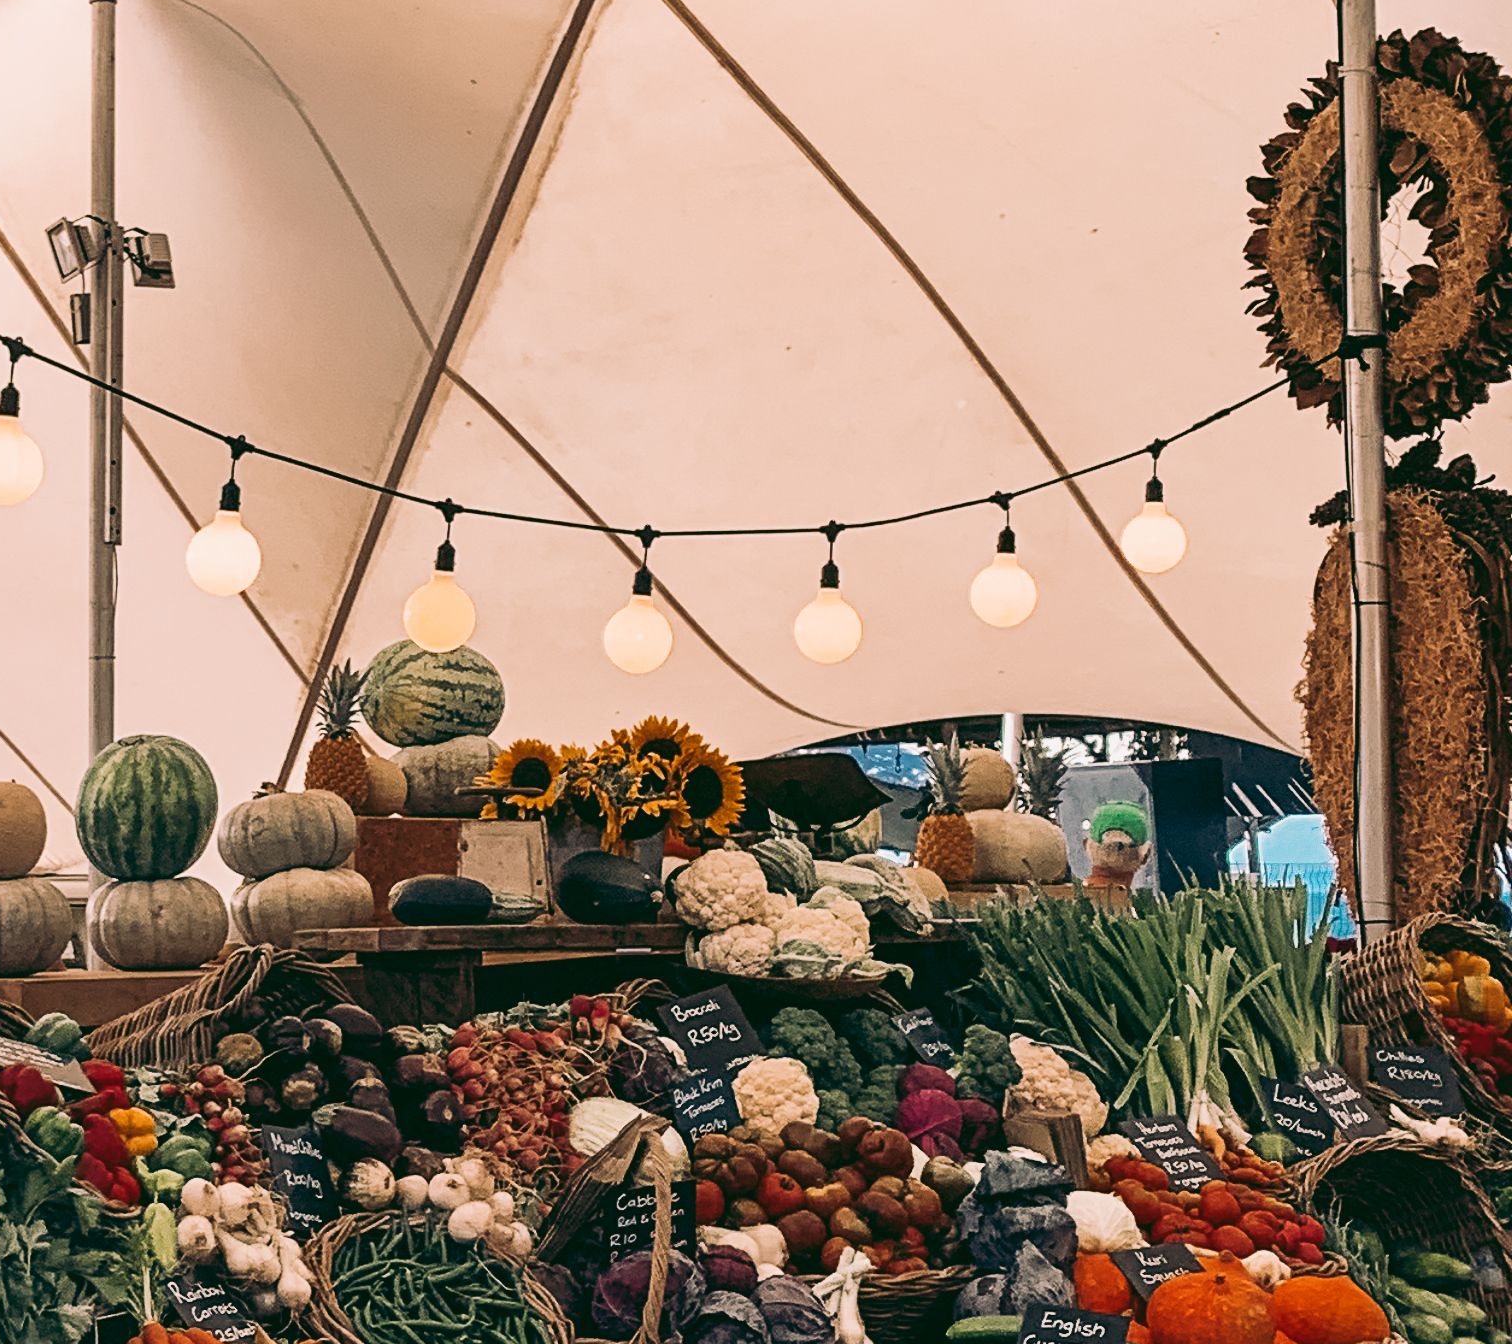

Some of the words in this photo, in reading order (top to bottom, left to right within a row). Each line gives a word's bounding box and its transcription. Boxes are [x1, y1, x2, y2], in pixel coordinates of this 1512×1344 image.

[687, 1021, 742, 1047] R50/kg
[673, 1087, 701, 1109] Black
[1273, 1083, 1318, 1113] Leeks
[616, 1192, 681, 1211] Cabbe
[617, 1215, 637, 1228] Red
[1134, 1251, 1168, 1267] Kuri
[167, 1280, 226, 1304] Rainbow
[191, 1302, 238, 1322] Carrots
[1040, 1311, 1106, 1338] English
